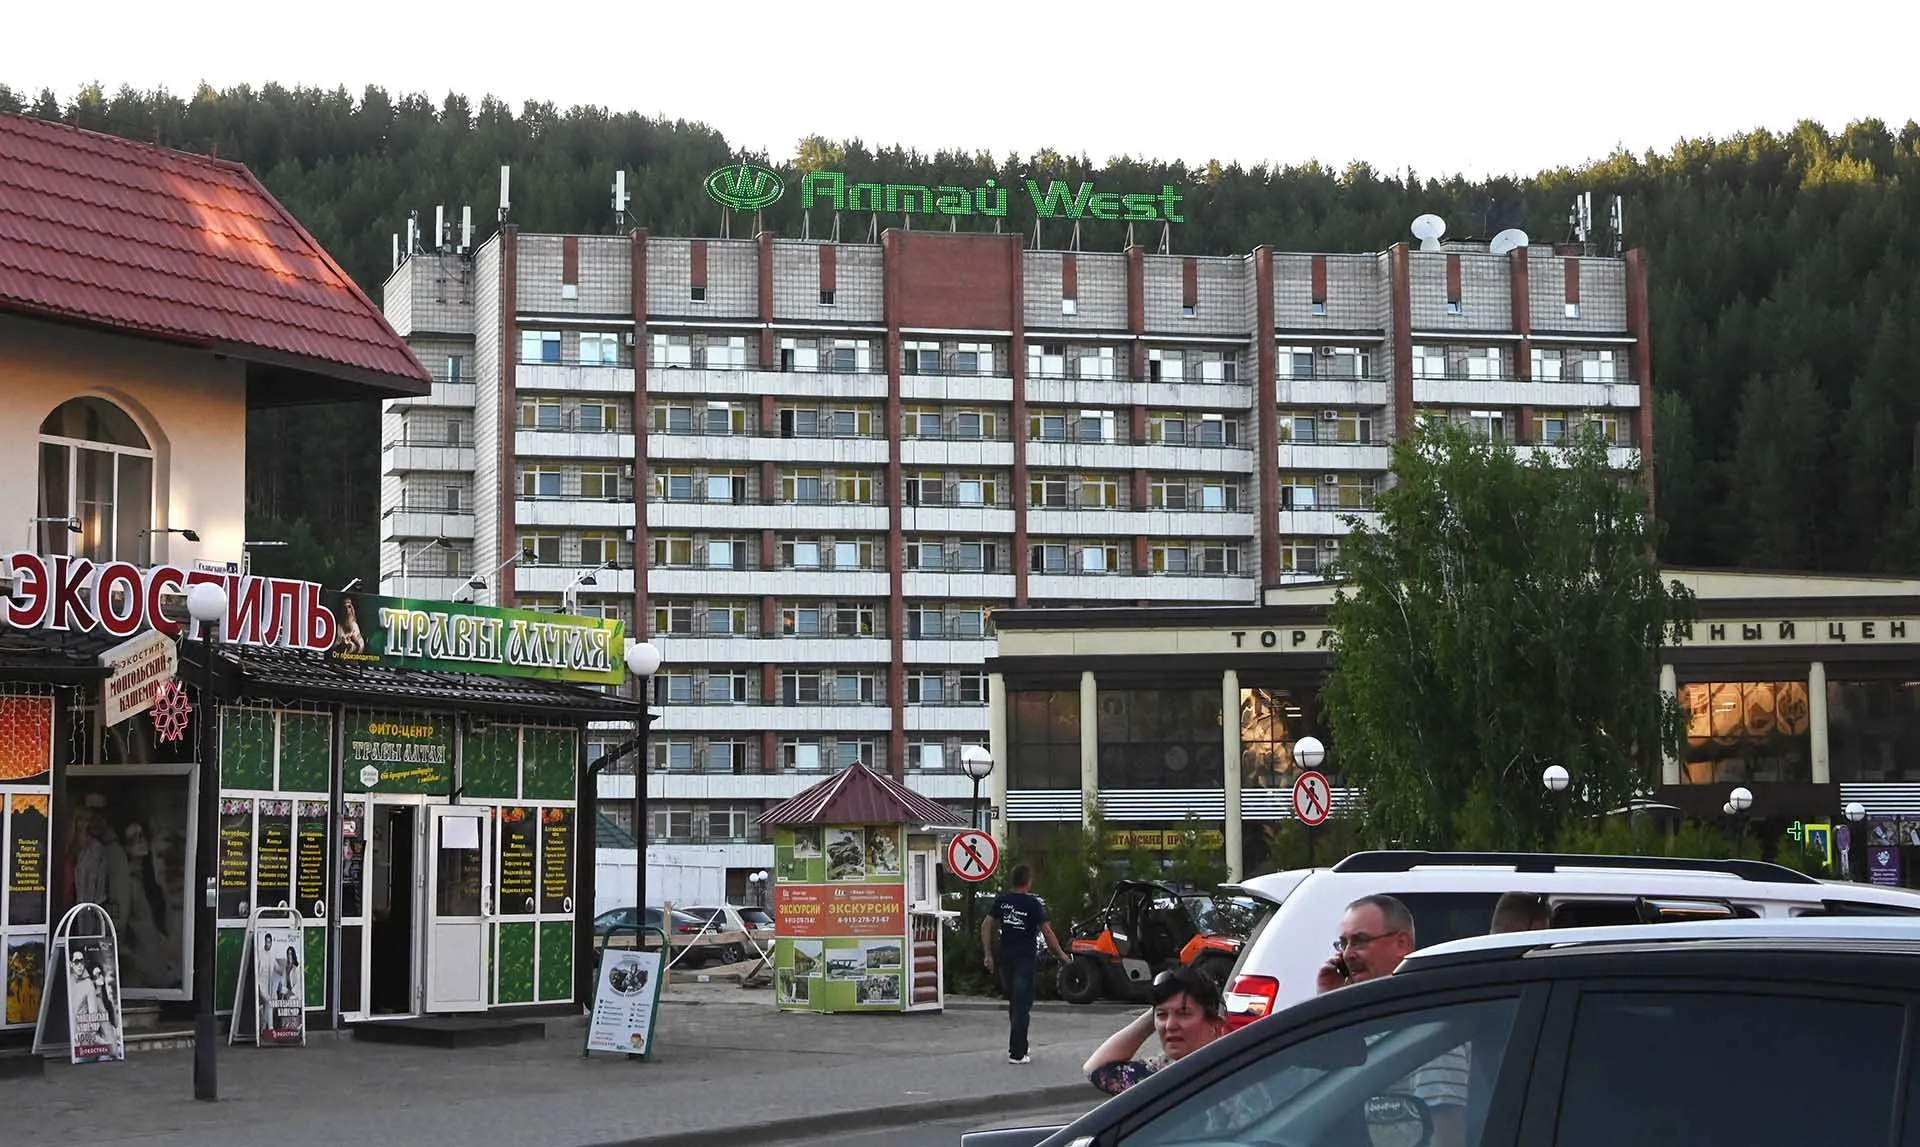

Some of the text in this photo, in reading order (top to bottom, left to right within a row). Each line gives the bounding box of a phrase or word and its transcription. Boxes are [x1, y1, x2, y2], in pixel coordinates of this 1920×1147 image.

[1025, 179, 1184, 223] West
[382, 607, 612, 673] ТРАВЫ АЛТАЯ
[121, 640, 166, 669] ЭКОСТИЛЬ
[110, 652, 167, 697] МОНГОЛЬСКИЙ
[368, 722, 434, 739] ФИТО-ЦЕНТР
[352, 741, 446, 764] ТРАВЫ АЛТАЯ
[779, 904, 821, 915] ЭКСКУРСИИ
[828, 903, 899, 914] ЭКСКУРСИИ
